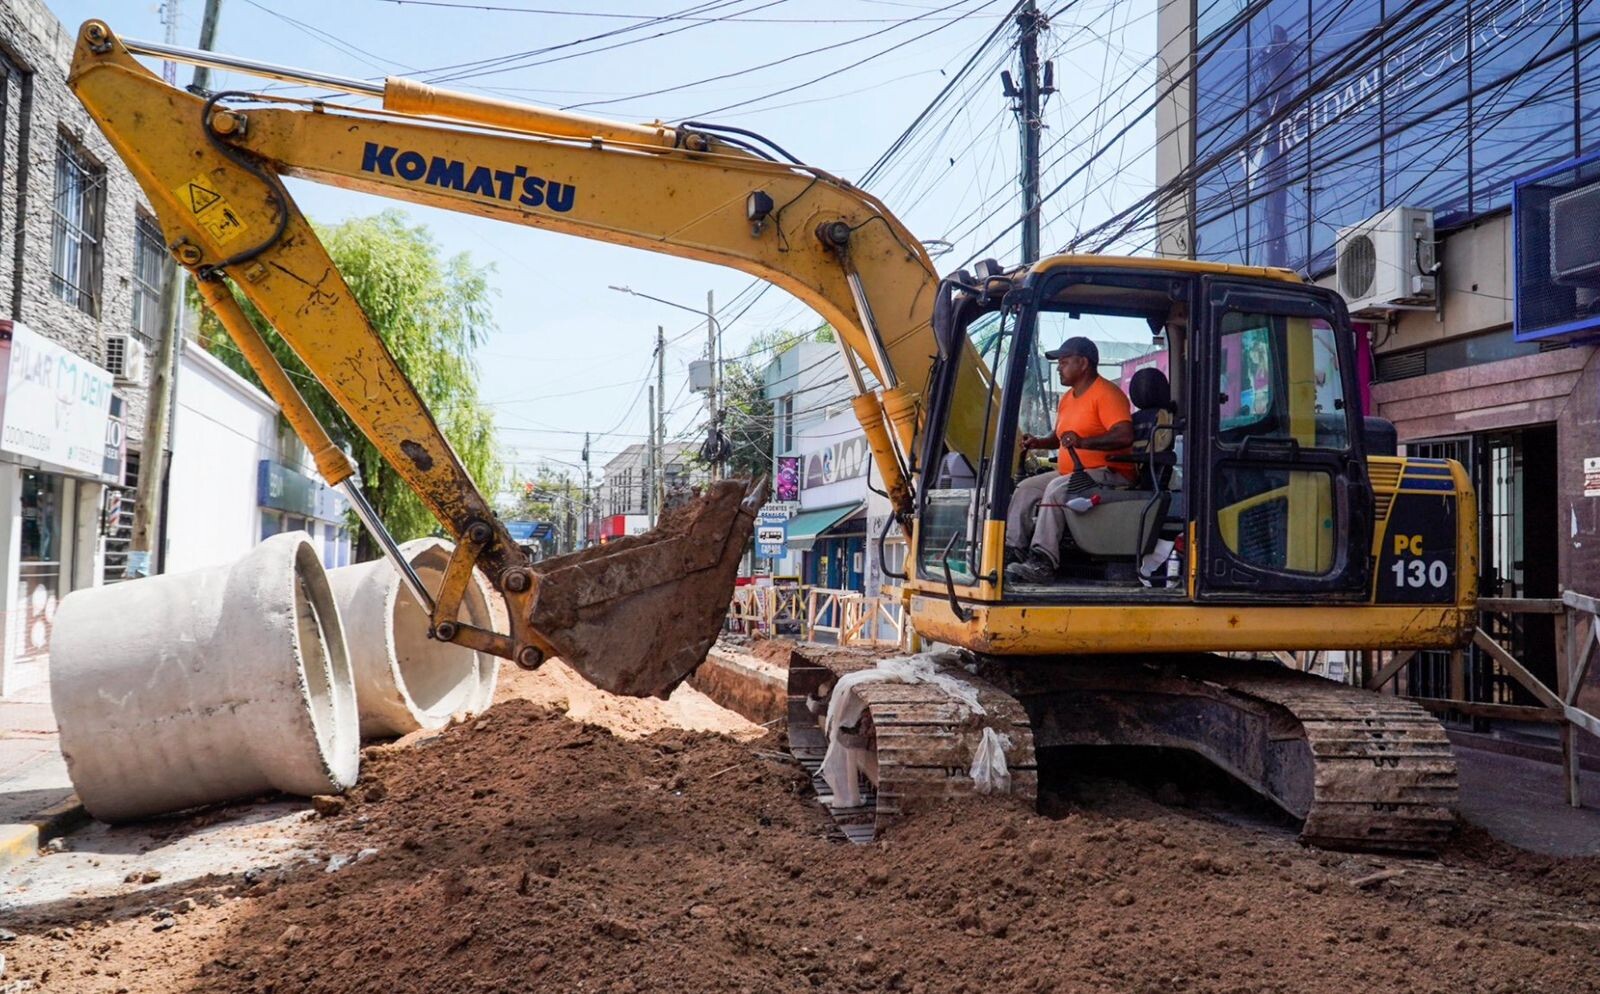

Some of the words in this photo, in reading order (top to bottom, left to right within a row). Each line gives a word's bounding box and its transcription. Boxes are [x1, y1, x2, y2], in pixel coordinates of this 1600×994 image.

[361, 141, 576, 212] KOMATSU
[11, 341, 53, 388] PILAR
[1394, 535, 1423, 556] PC
[1391, 560, 1448, 588] 130
